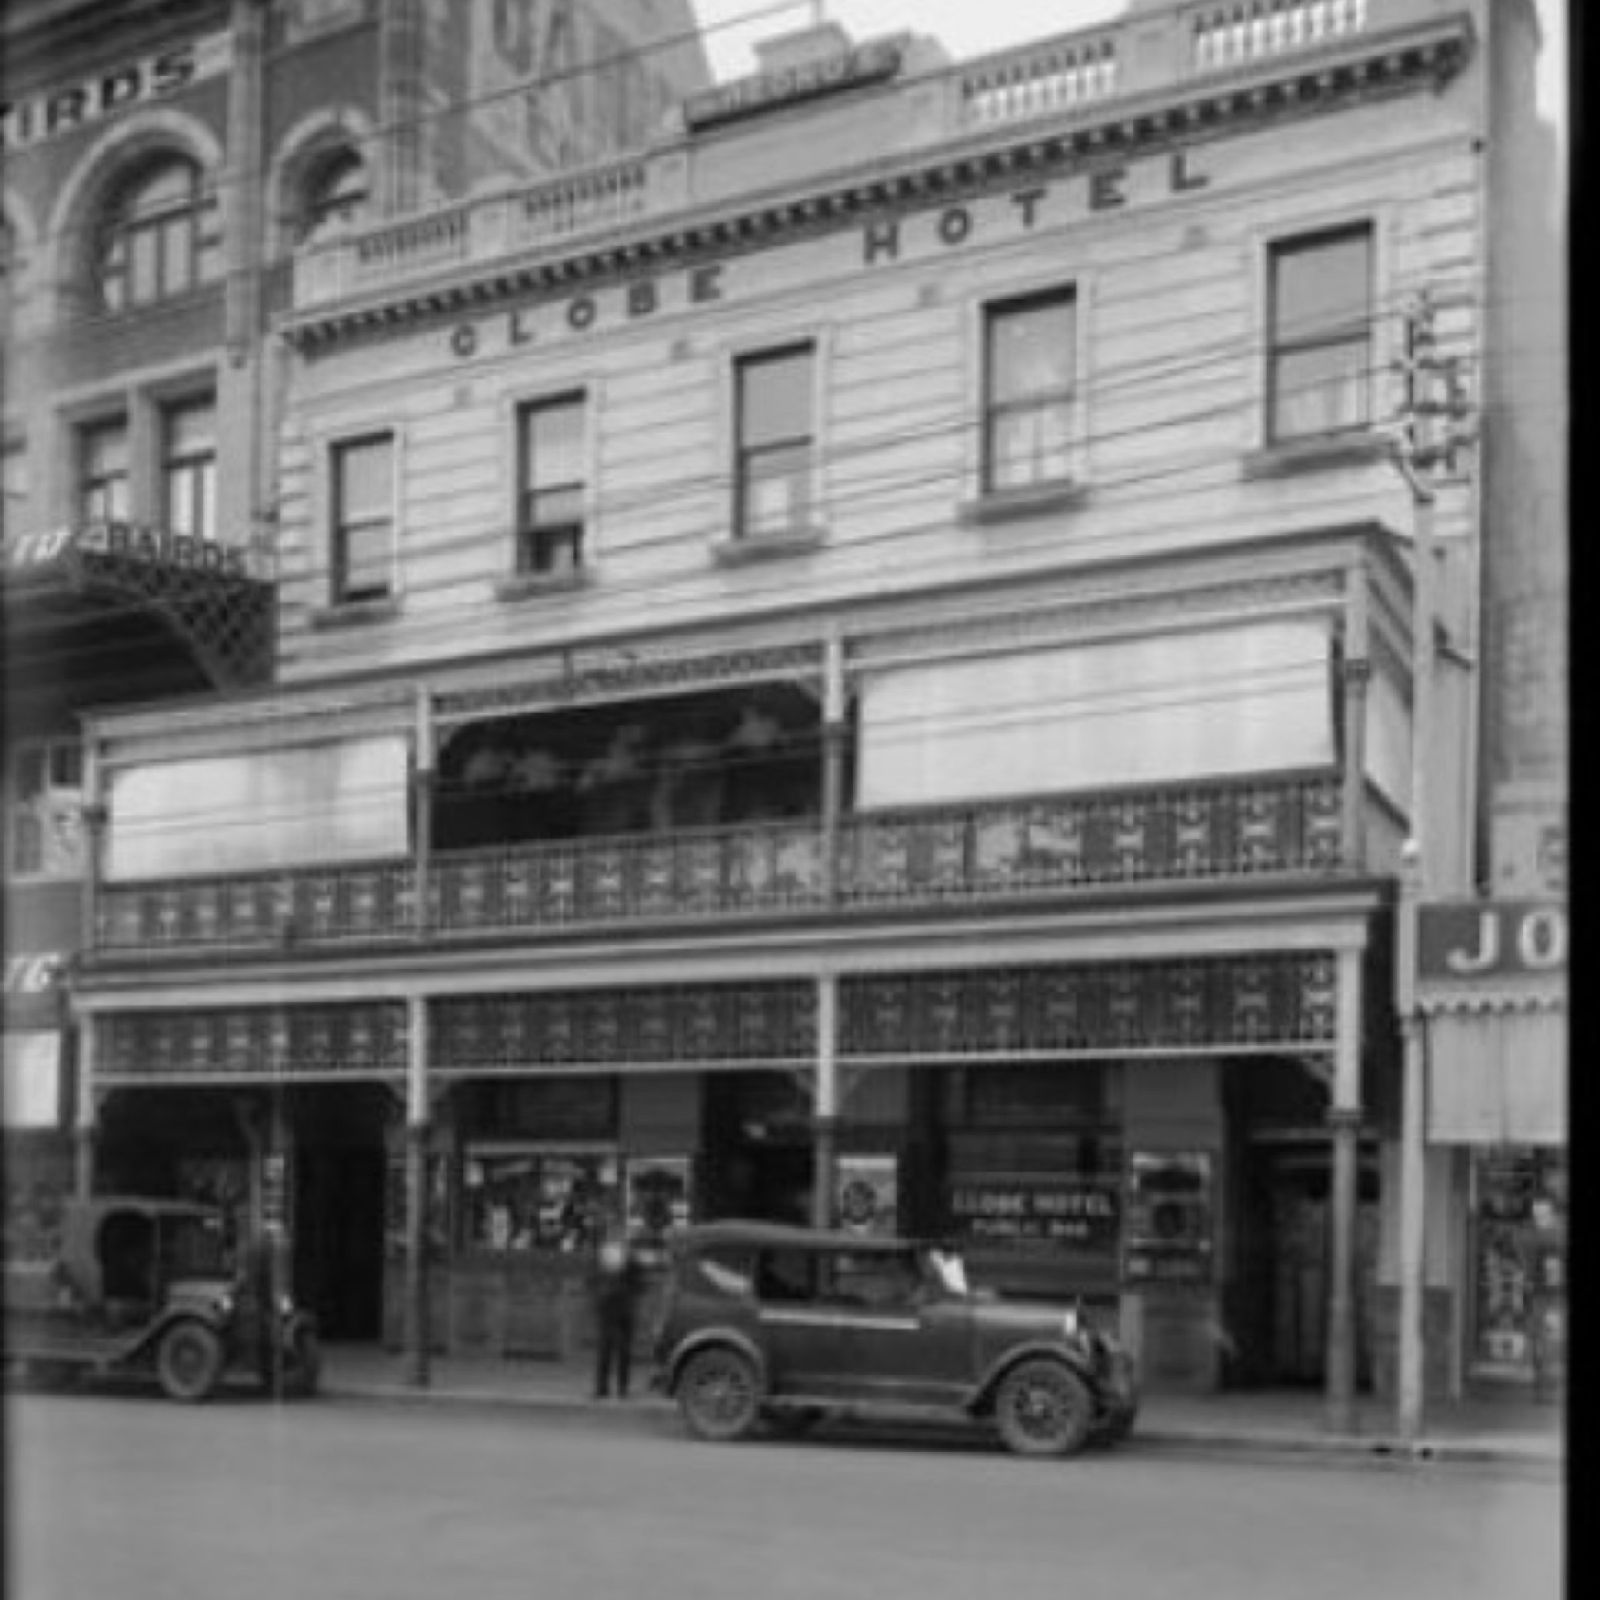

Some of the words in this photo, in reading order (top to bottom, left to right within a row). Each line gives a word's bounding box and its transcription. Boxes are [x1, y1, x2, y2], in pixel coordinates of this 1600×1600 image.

[451, 264, 722, 356] GLOBE
[863, 153, 1211, 264] HOTEL
[1447, 911, 1566, 971] JO
